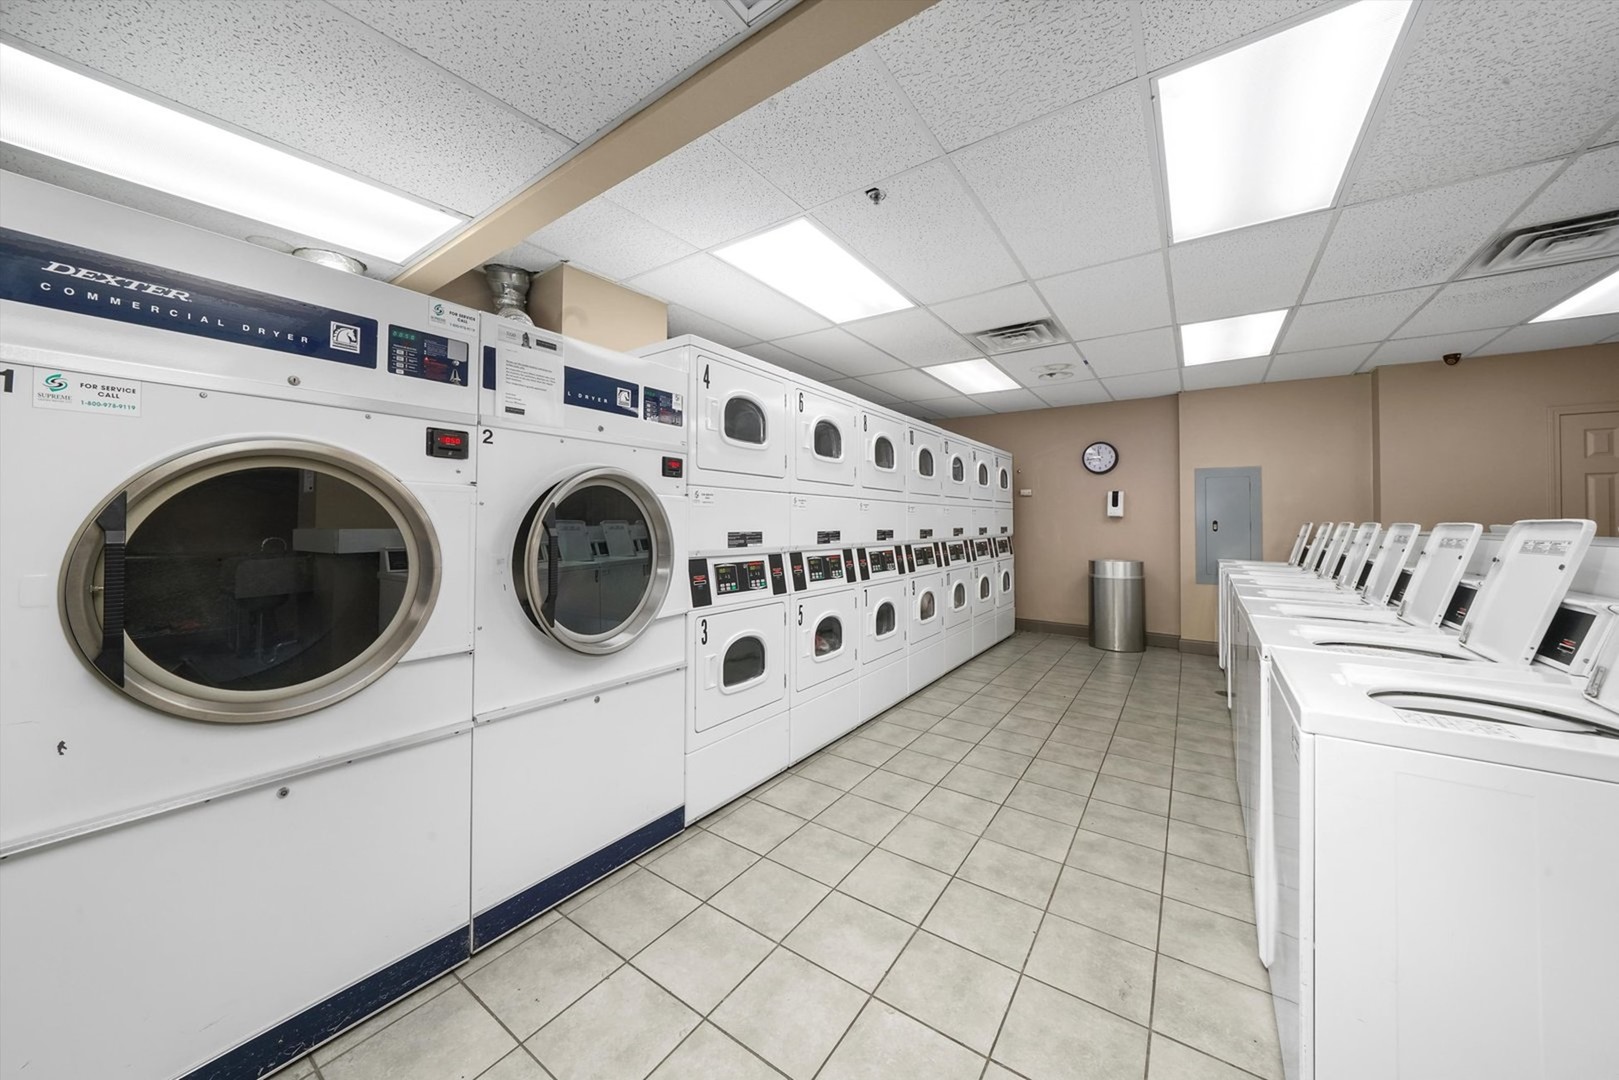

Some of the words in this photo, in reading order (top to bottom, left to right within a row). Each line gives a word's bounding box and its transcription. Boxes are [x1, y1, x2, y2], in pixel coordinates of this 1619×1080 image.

[41, 260, 192, 303] DEXTER
[40, 282, 225, 327] COMMERCIAL
[242, 324, 309, 344] DRYER
[0, 368, 14, 393] 1
[703, 364, 710, 389] 4
[37, 391, 72, 401] SUPREME
[80, 382, 98, 390] FOR
[101, 384, 137, 394] SERVICE
[97, 391, 120, 399] CALL
[578, 392, 608, 404] DRYER
[81, 400, 136, 410] 1-800-978-9119
[798, 392, 804, 413] 6
[482, 429, 494, 445] 2
[798, 605, 804, 626] 5
[701, 619, 708, 645] 3
